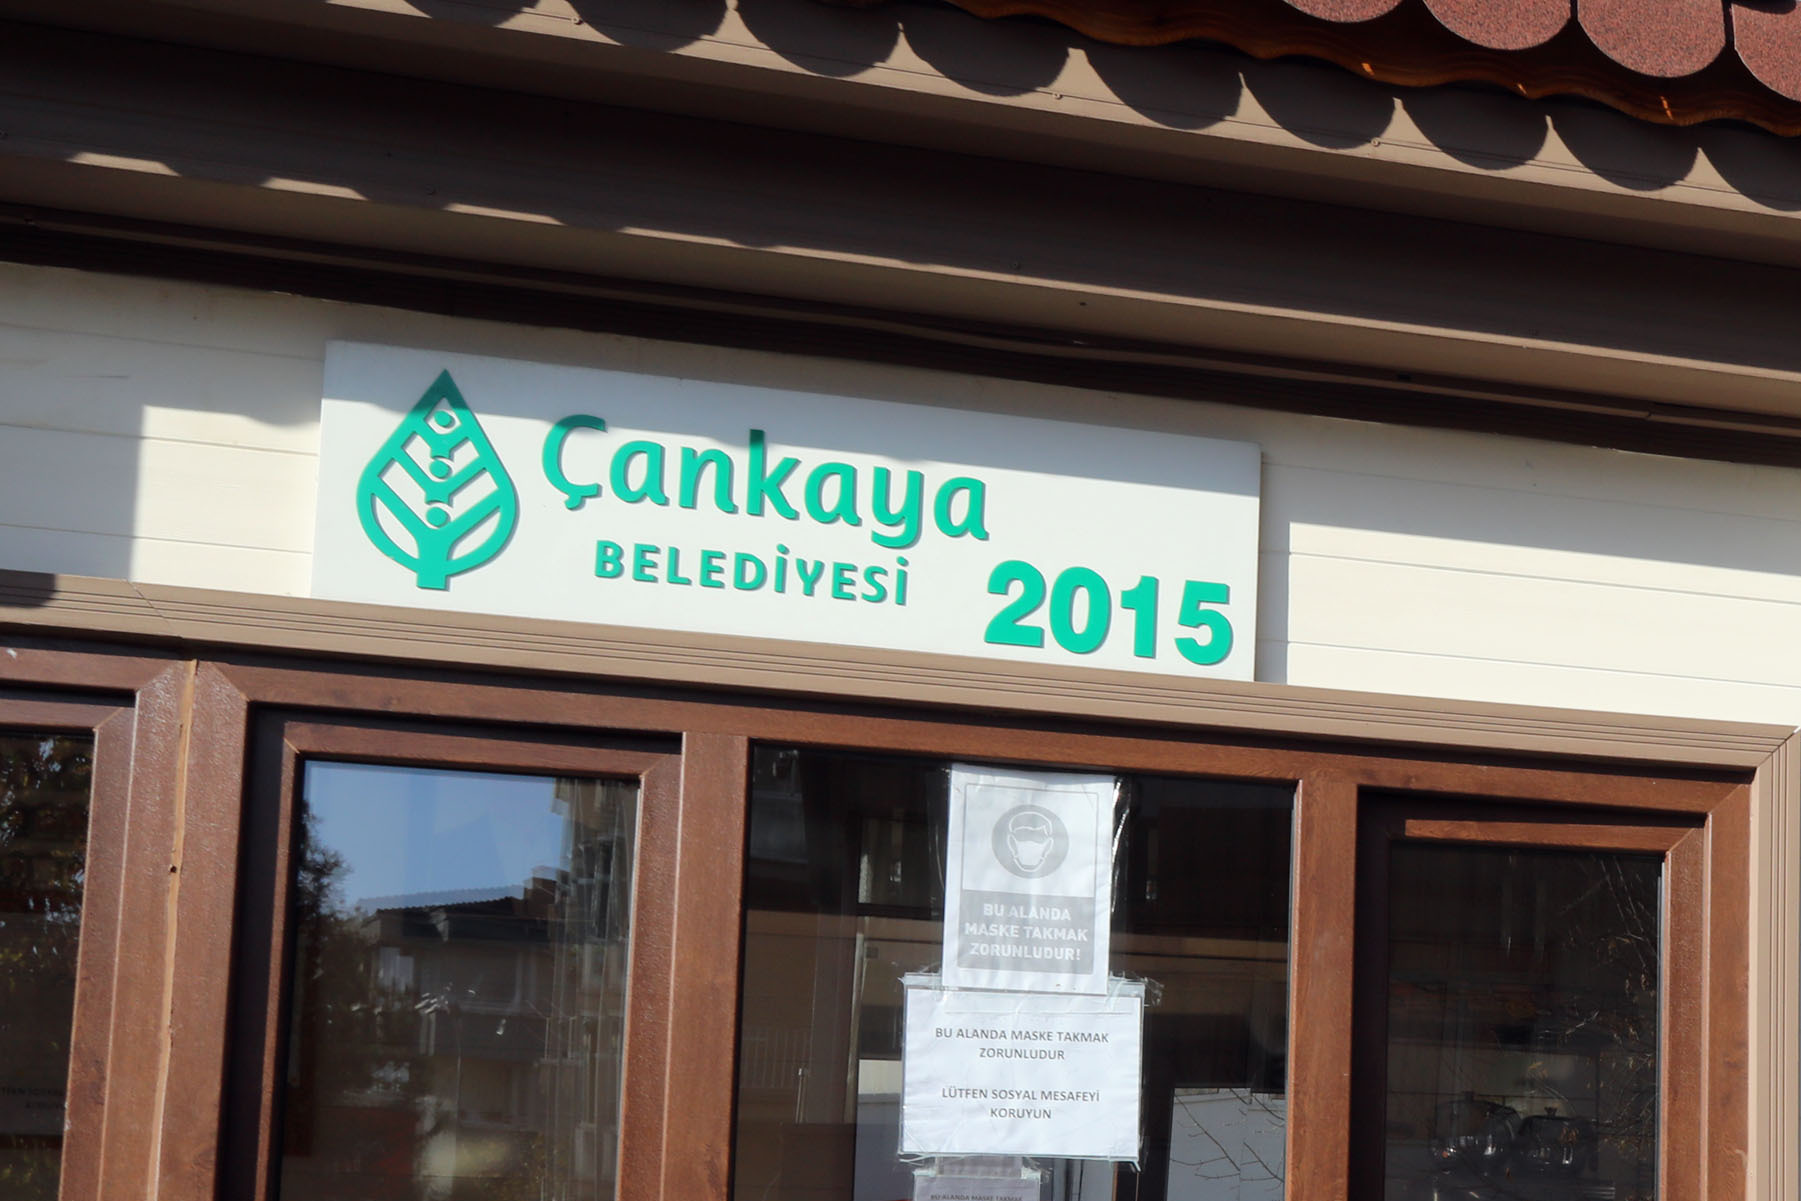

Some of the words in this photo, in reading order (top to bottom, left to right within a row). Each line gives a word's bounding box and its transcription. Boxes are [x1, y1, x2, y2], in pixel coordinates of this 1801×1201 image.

[542, 414, 989, 548] Çankaya
[594, 539, 908, 605] BELEDİYESİ
[984, 558, 1233, 665] 2015
[983, 903, 1003, 918] BU
[1009, 905, 1071, 921] ALANDA
[965, 922, 1019, 938] MASKE
[1023, 925, 1088, 942] TAKMAK
[970, 942, 1080, 960] ZORUNLUDUR!
[935, 1027, 951, 1038] BU
[956, 1028, 1007, 1040] ALANDA
[1011, 1030, 1053, 1041] MASKE
[1058, 1031, 1108, 1043] TAKMAK
[979, 1047, 1065, 1060] ZORUNLUDUR
[942, 1086, 987, 1099] LÜTFEN
[991, 1089, 1037, 1100] SOSYAL
[1041, 1090, 1100, 1102] MESAFEYİ
[990, 1108, 1051, 1119] KORUYUN
